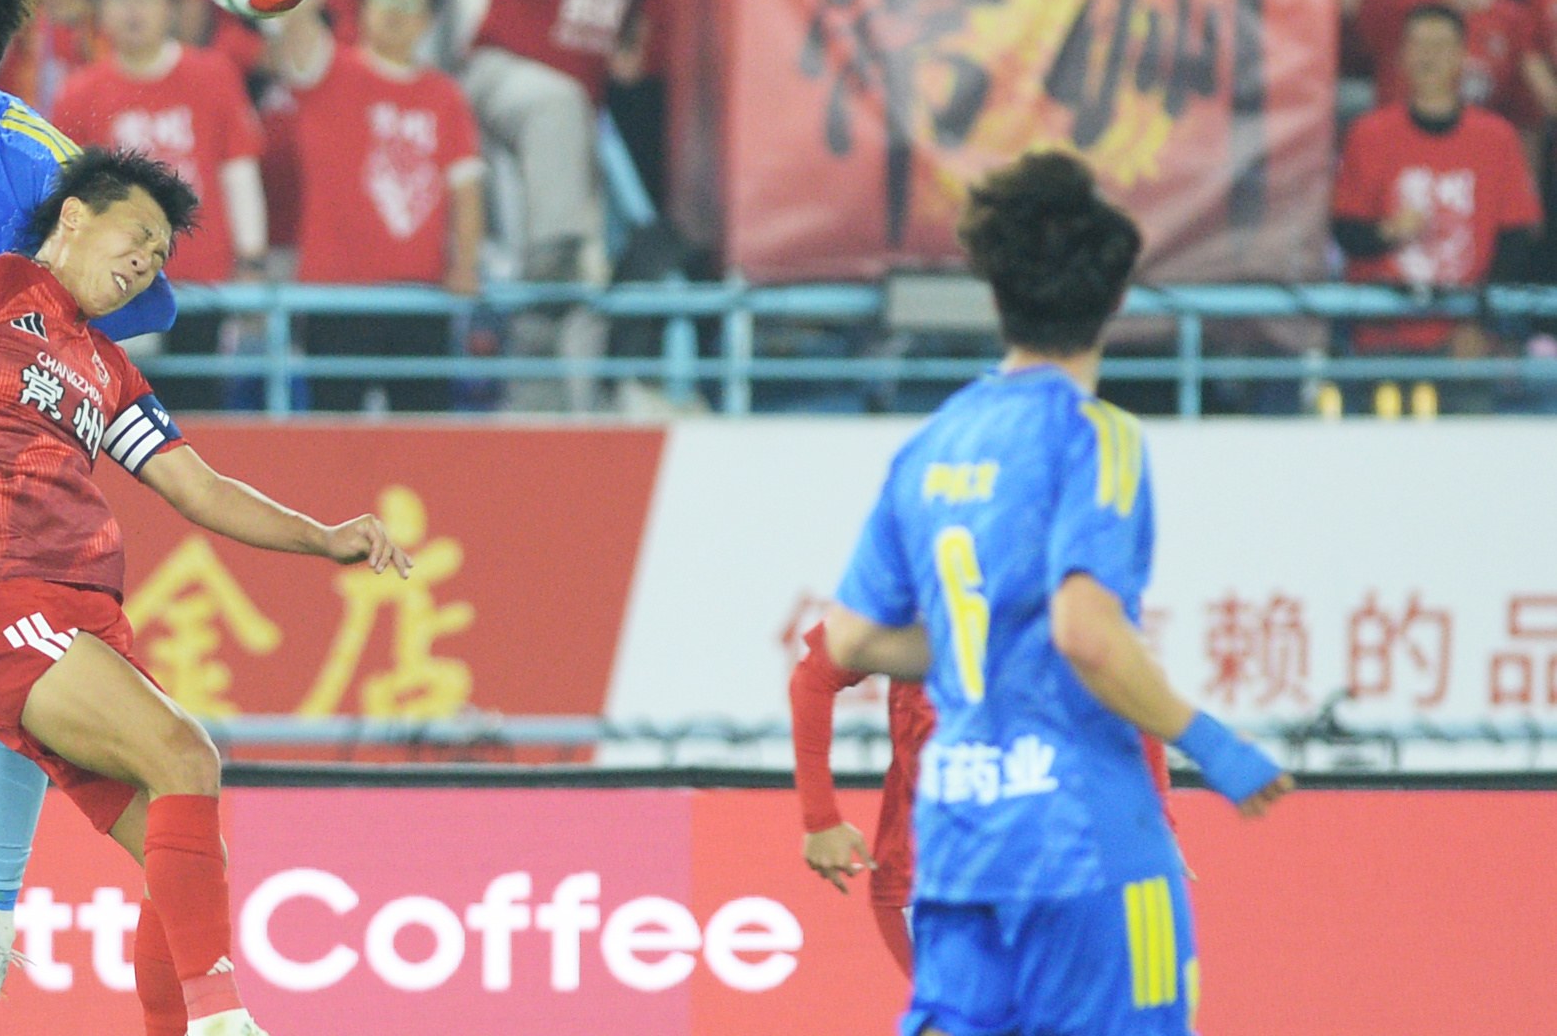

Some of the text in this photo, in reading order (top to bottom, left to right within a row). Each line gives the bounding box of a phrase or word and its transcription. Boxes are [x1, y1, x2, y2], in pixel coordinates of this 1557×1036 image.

[19, 364, 104, 460] 常州
[36, 351, 103, 406] CHANGZHOU
[935, 525, 991, 704] 6
[240, 868, 804, 991] Coffee
